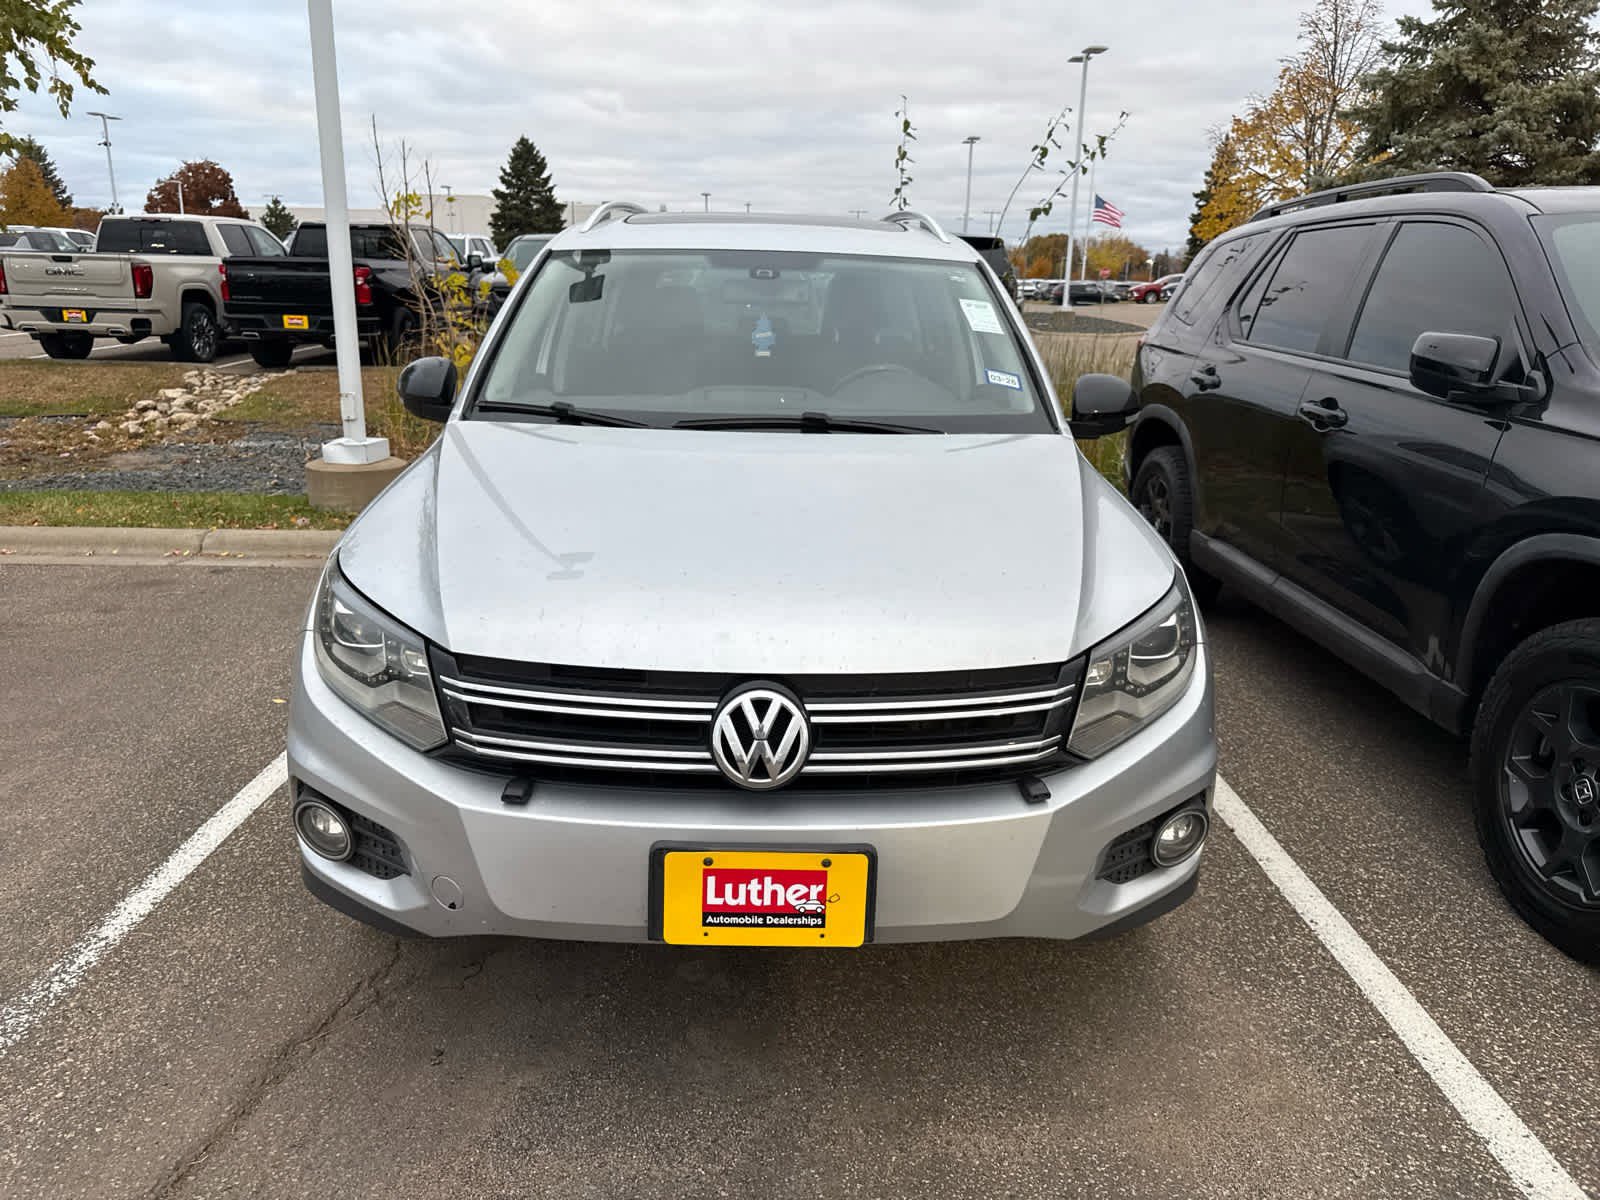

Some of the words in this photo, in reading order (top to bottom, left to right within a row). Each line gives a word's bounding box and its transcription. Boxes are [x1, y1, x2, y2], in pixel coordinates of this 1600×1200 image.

[45, 265, 84, 276] GMC
[706, 875, 824, 906] Luther
[706, 915, 763, 924] Automobile
[766, 916, 822, 926] Dealerships
